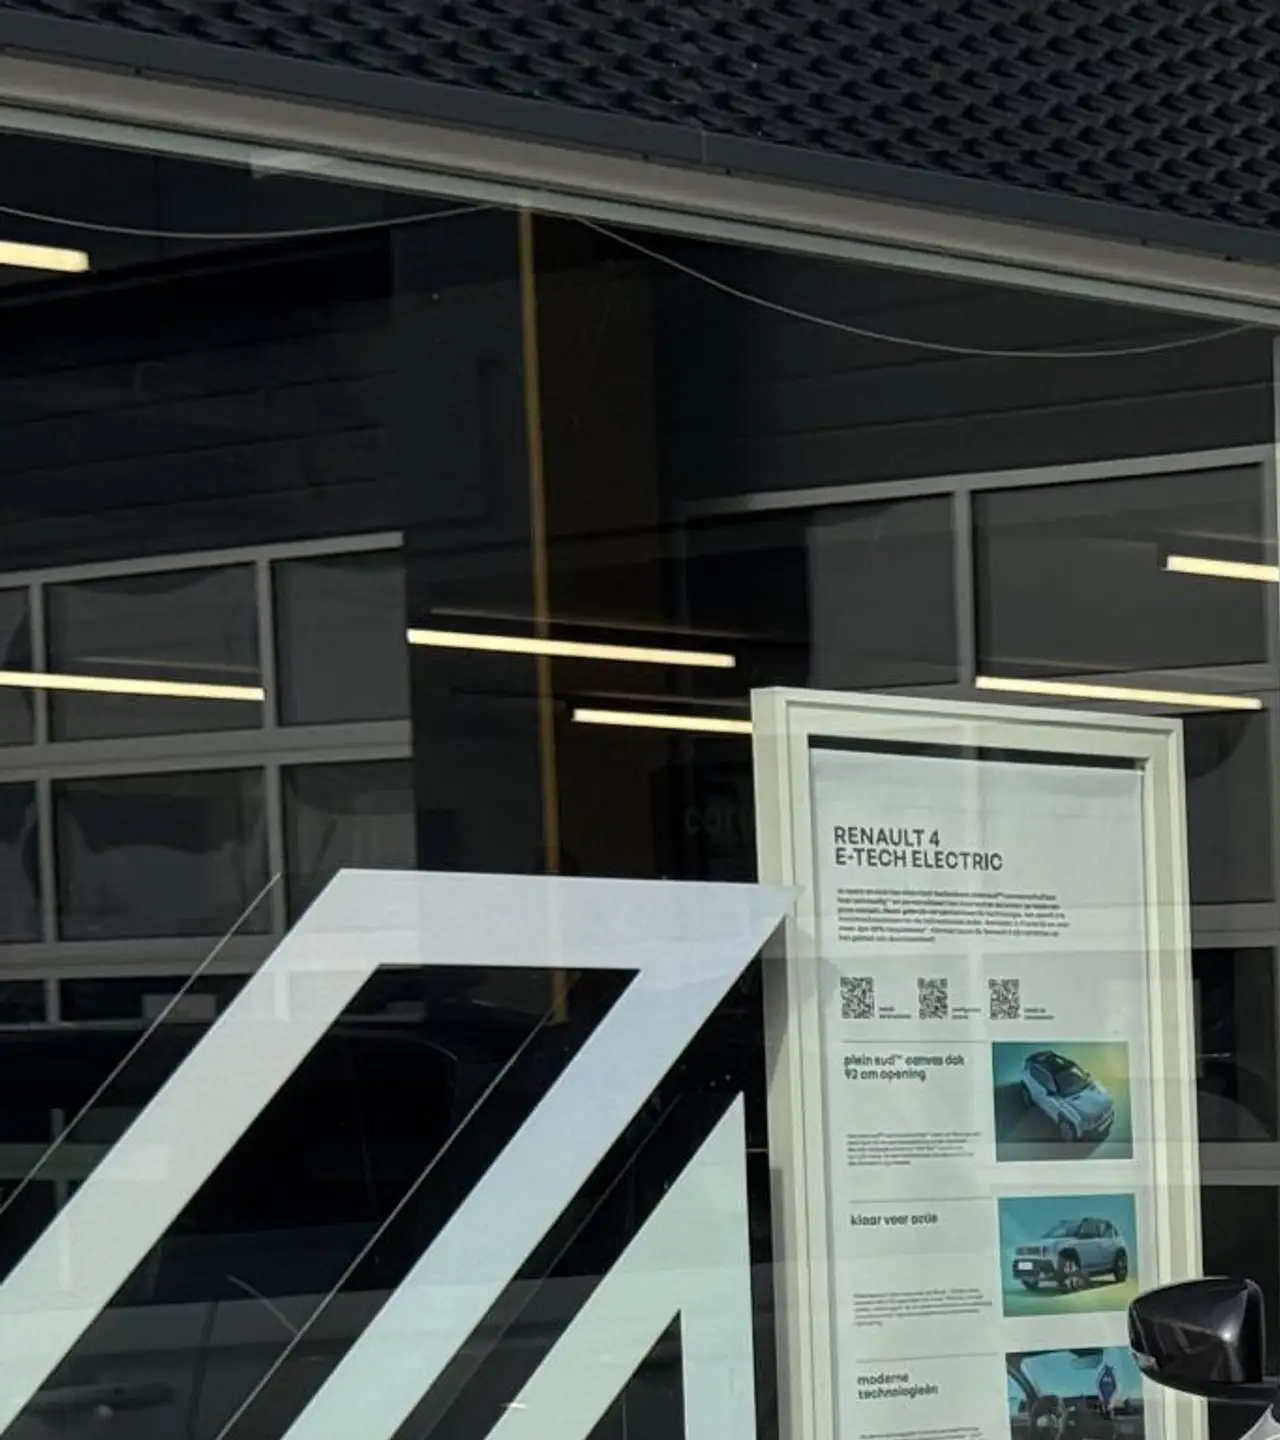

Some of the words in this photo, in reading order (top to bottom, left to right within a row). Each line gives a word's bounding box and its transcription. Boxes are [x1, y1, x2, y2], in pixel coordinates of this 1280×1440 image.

[833, 825, 925, 847] RENAULT
[928, 829, 941, 848] 4
[835, 847, 907, 868] E-TECH
[911, 850, 1004, 872] ELECTRIC
